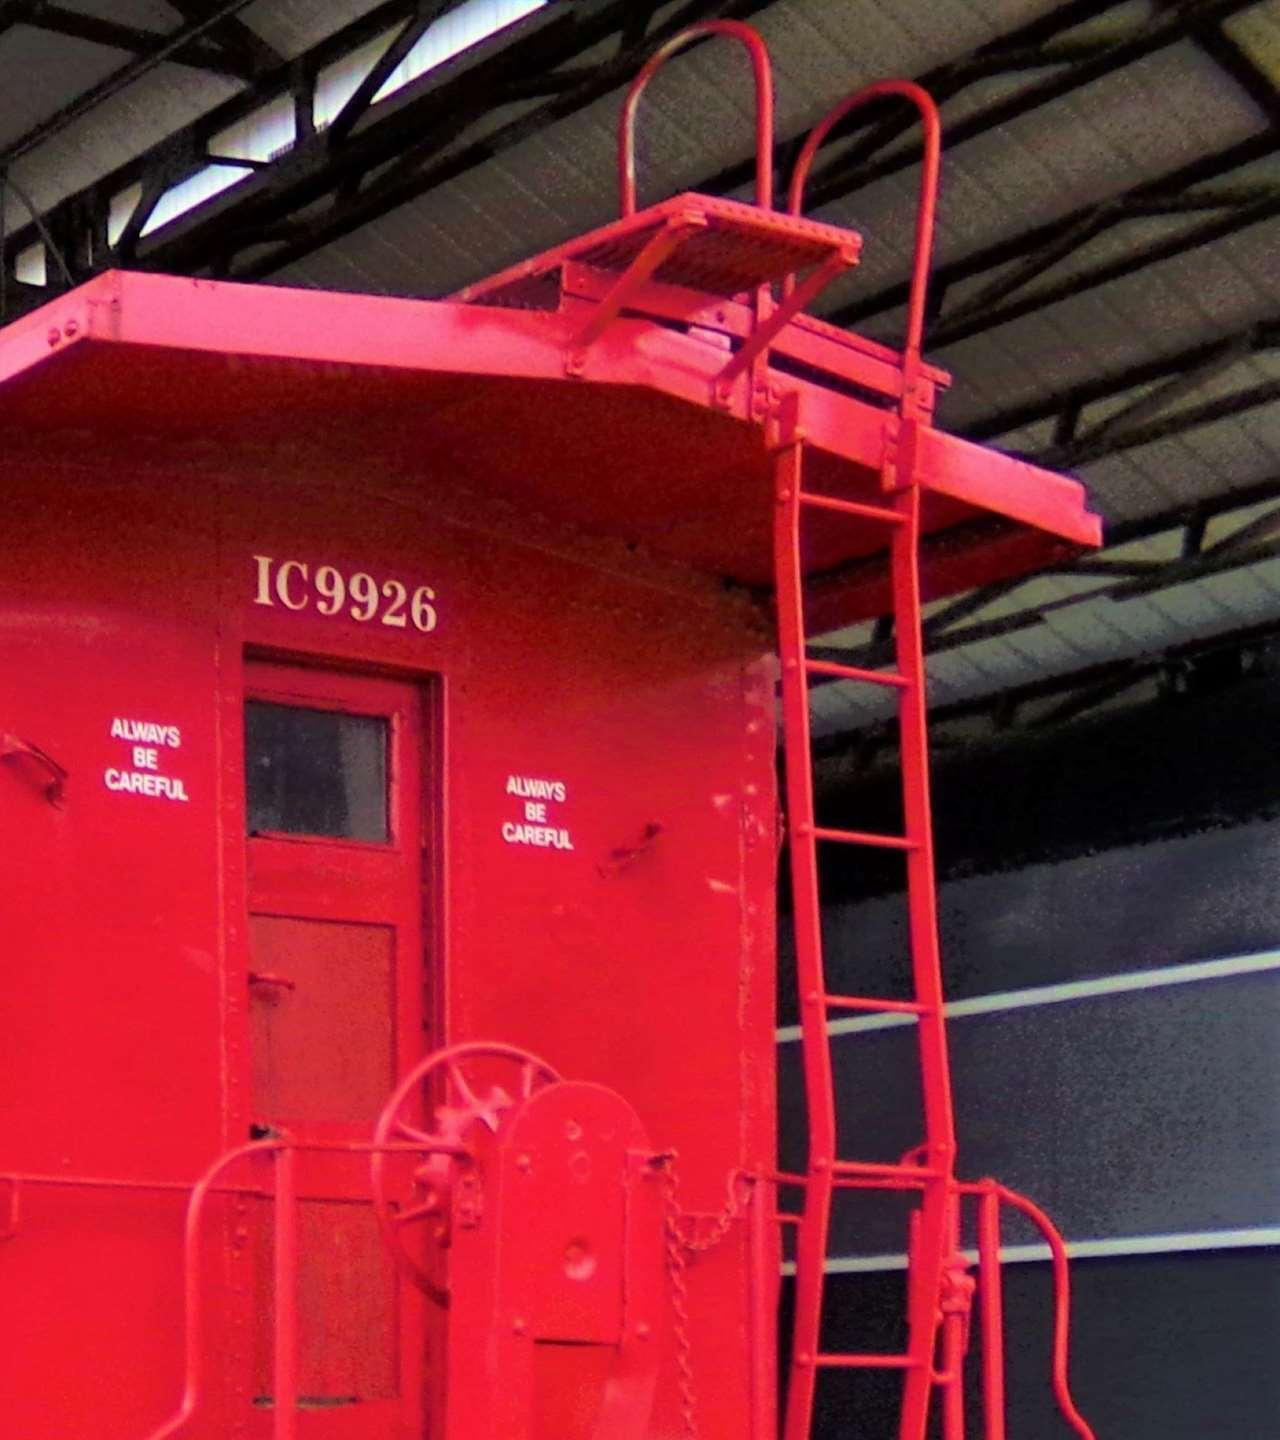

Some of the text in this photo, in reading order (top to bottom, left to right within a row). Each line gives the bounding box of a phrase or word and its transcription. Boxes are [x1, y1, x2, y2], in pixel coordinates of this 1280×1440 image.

[252, 554, 438, 633] IC9926
[110, 717, 181, 749] ALWAYS
[133, 746, 158, 771] BE
[104, 768, 189, 801] CAREFUL
[506, 774, 566, 803] ALWAYS
[525, 800, 546, 823] BE
[502, 821, 574, 850] CAREFUL
